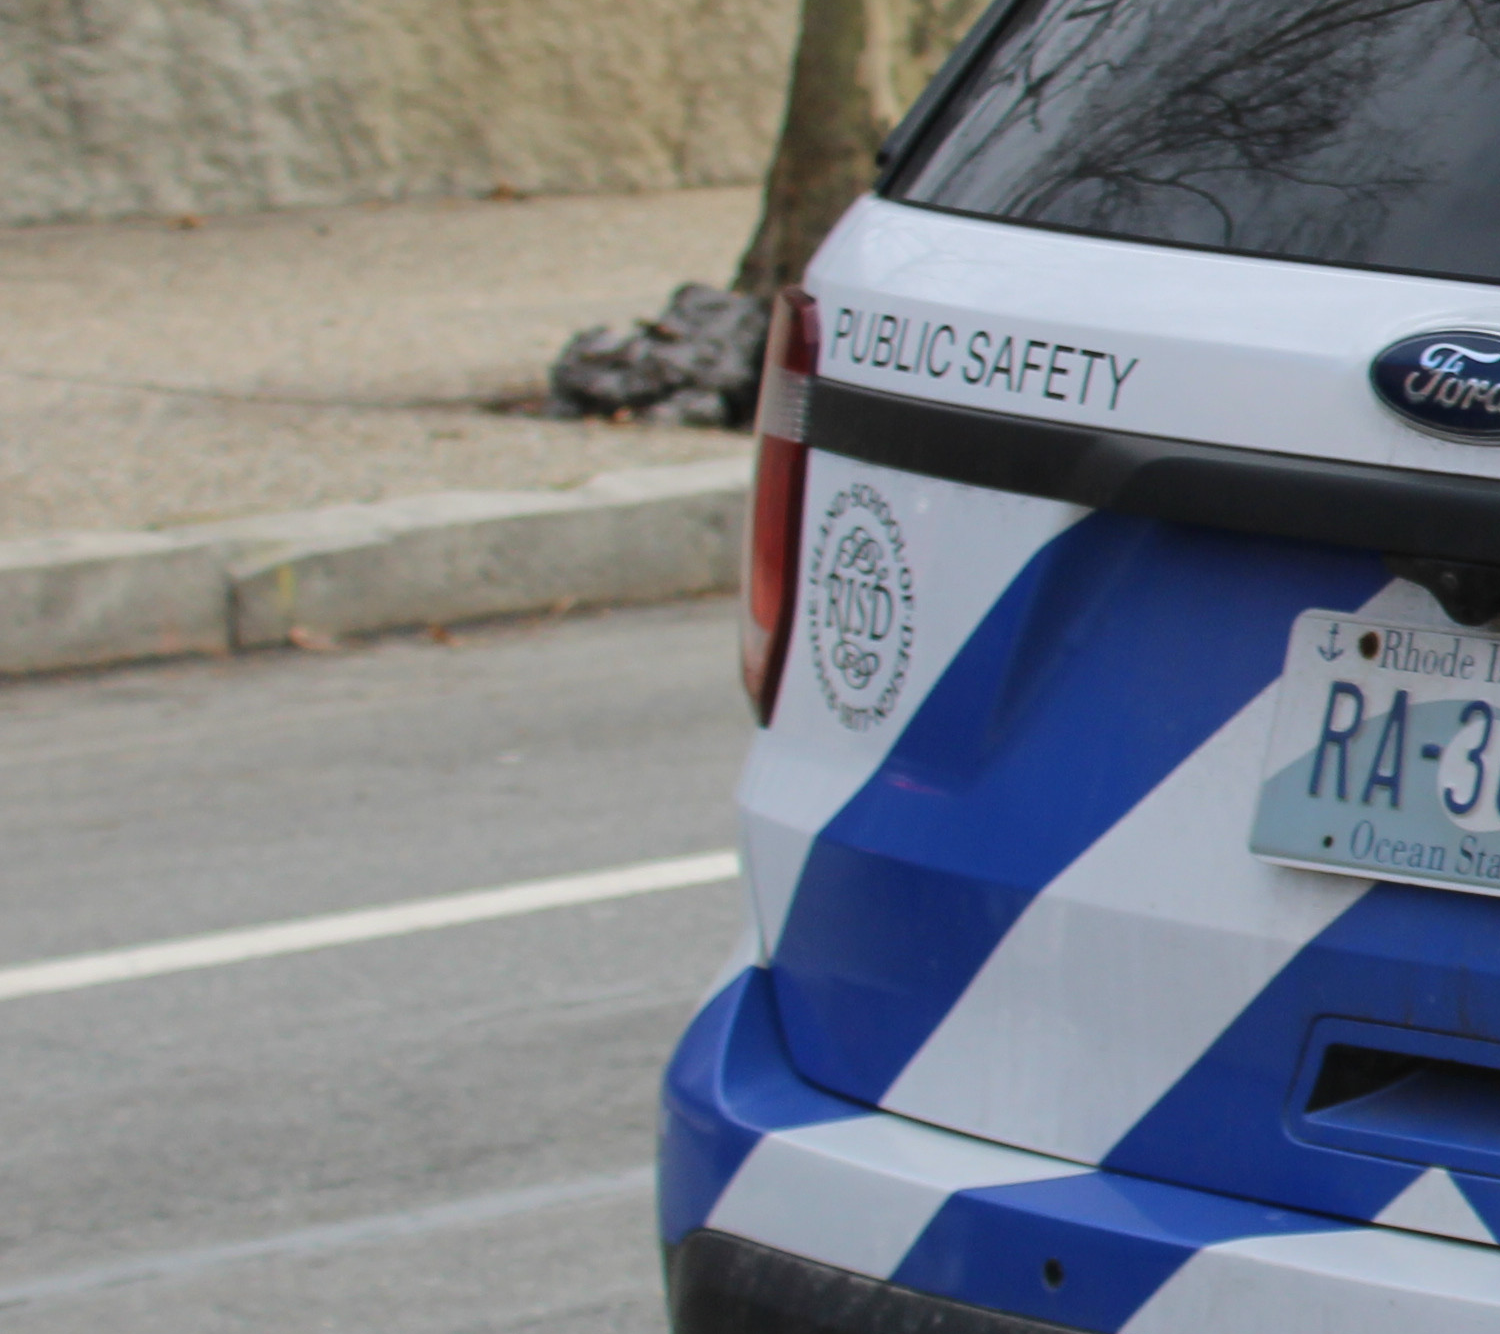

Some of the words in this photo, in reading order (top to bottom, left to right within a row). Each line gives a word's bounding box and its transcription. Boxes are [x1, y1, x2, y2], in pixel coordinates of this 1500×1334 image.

[829, 308, 955, 379] PUBLIC
[961, 330, 1139, 411] SAFETY
[1378, 629, 1476, 681] Rhode
[1348, 819, 1447, 868] Ocean
